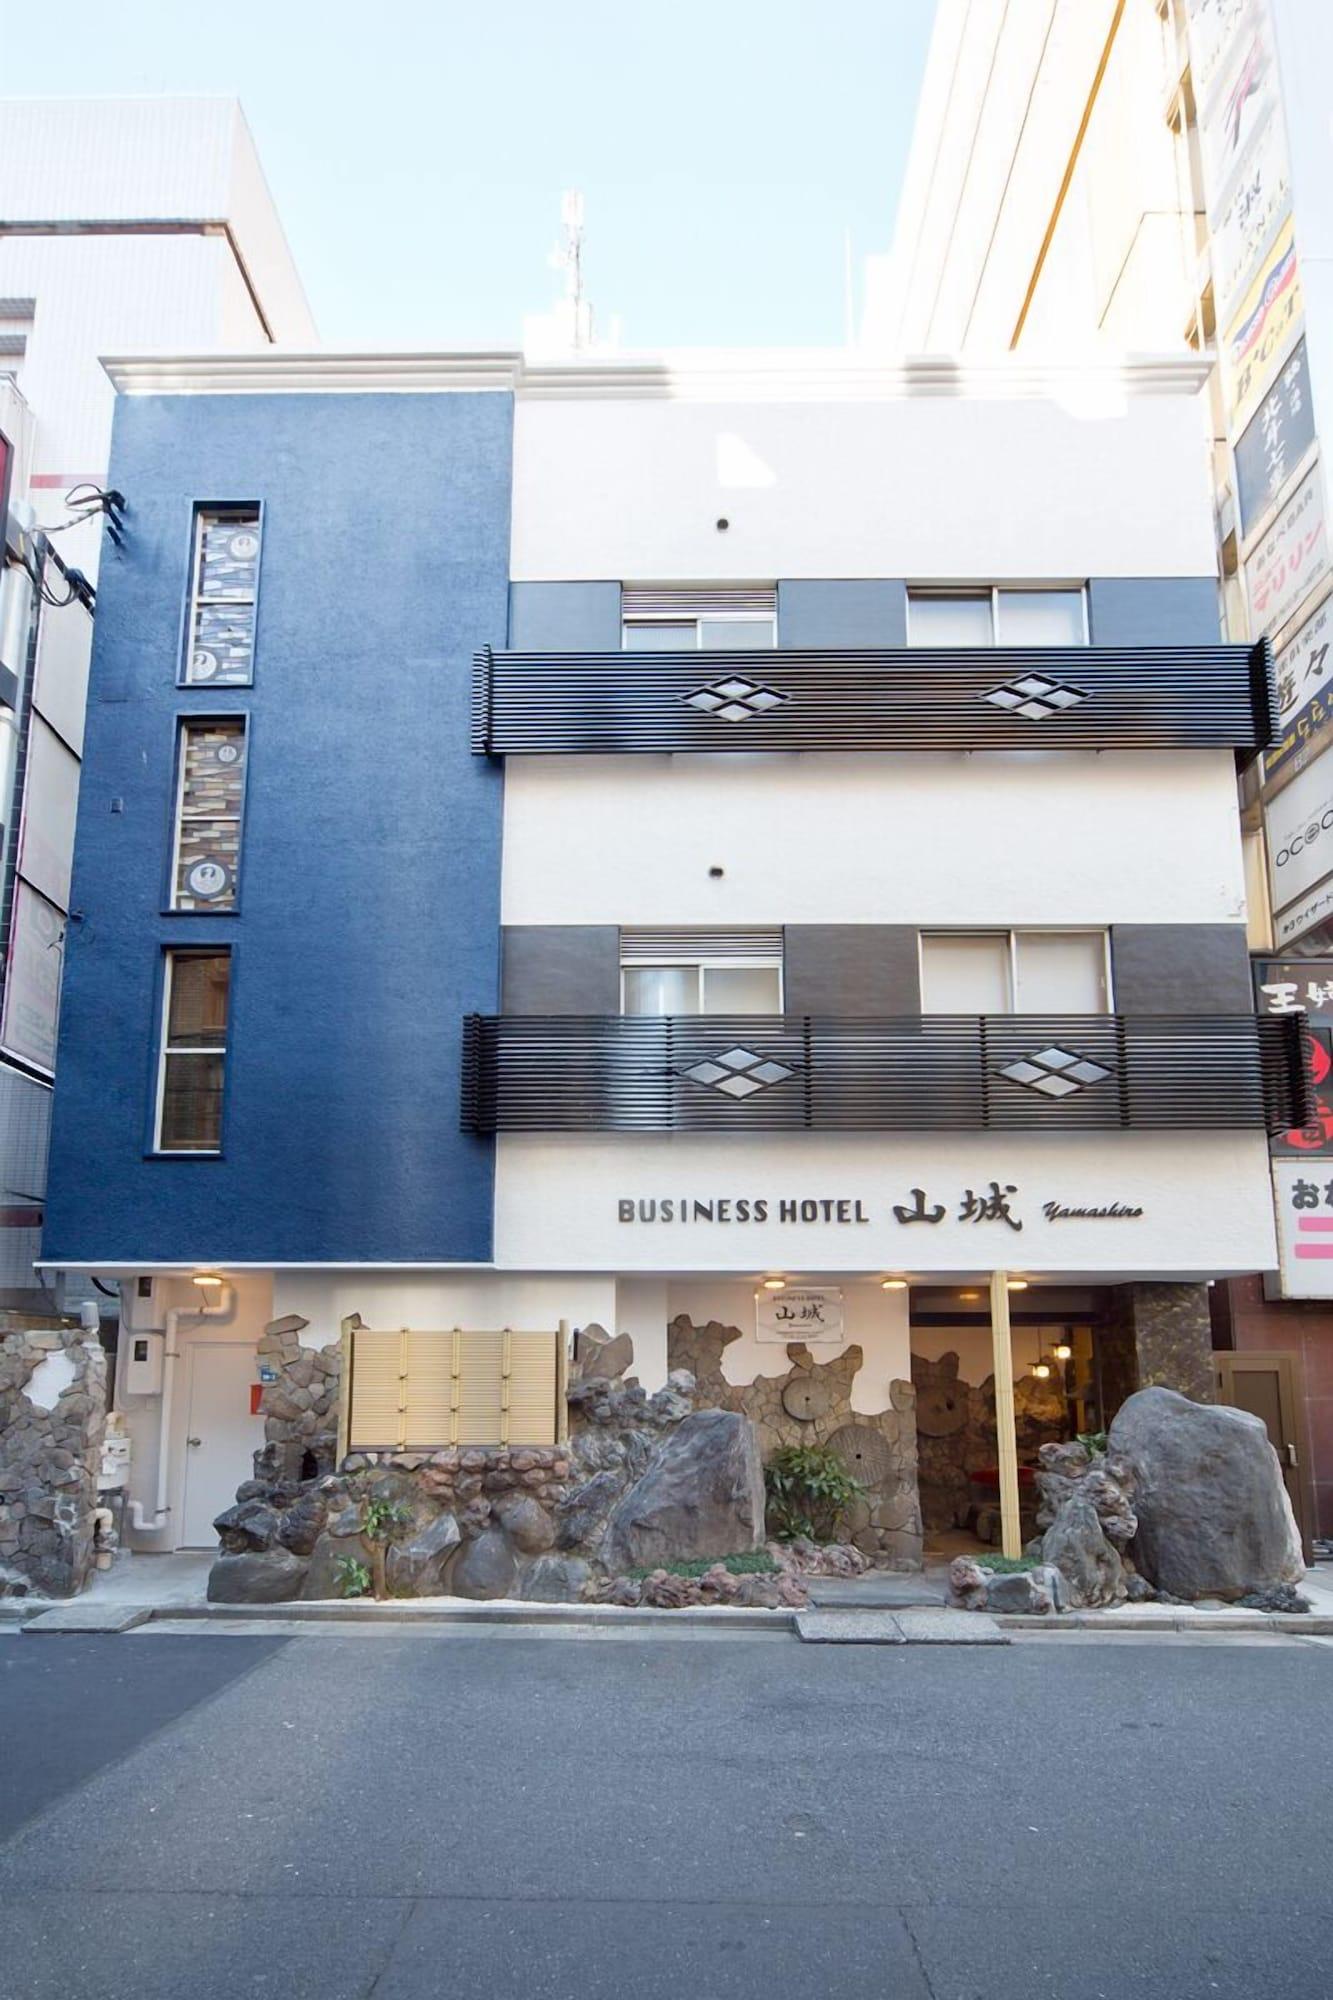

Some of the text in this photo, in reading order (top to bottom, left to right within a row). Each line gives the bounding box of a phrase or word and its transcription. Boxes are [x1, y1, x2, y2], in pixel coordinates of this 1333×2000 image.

[617, 1181, 1144, 1232] BUSINESS HOTEL 山城 Yamashiro
[775, 1304, 825, 1323] 山城
